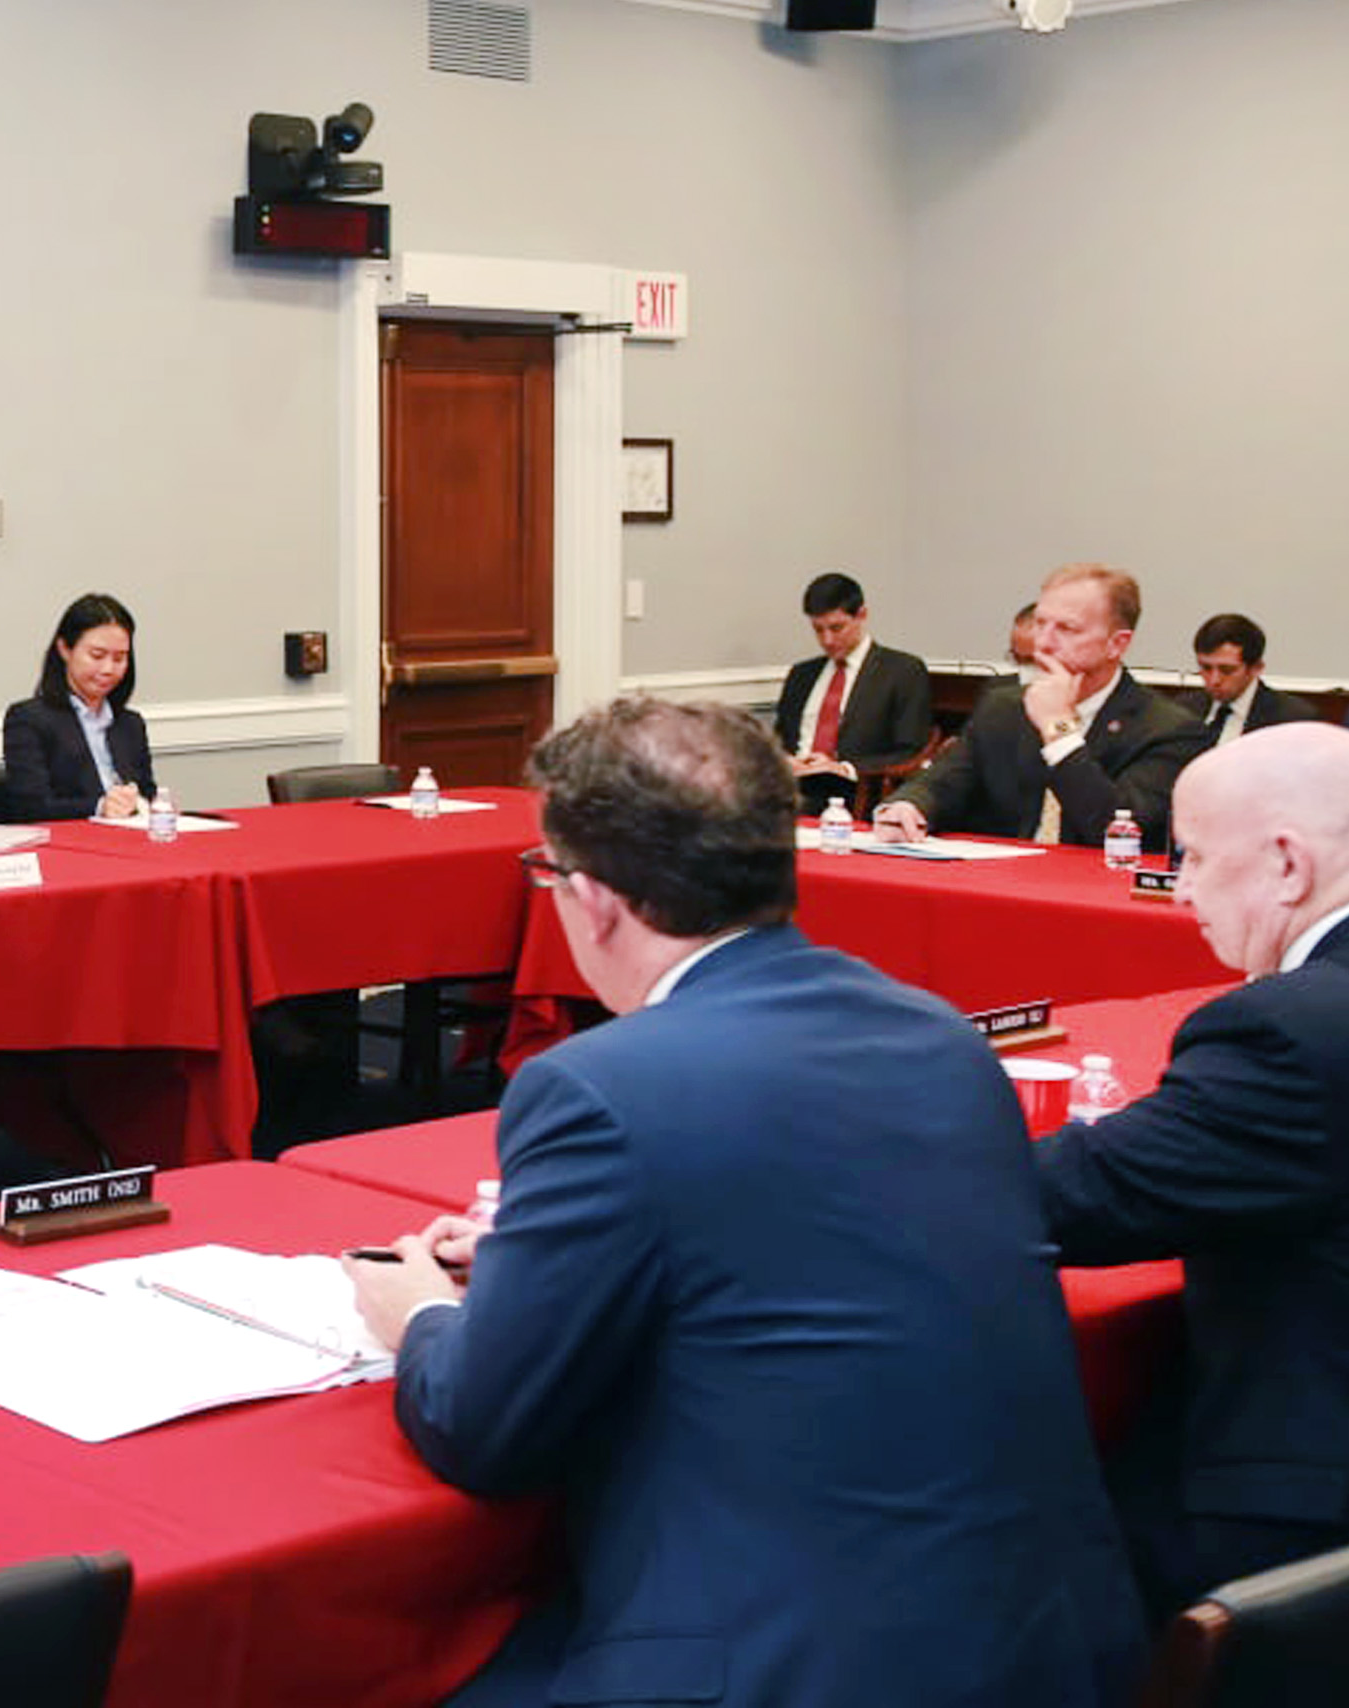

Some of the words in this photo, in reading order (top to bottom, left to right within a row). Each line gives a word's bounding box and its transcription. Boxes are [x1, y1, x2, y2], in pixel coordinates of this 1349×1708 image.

[636, 281, 676, 328] EXIT
[49, 1185, 100, 1210] SMITH
[108, 1177, 141, 1199] (NE)
